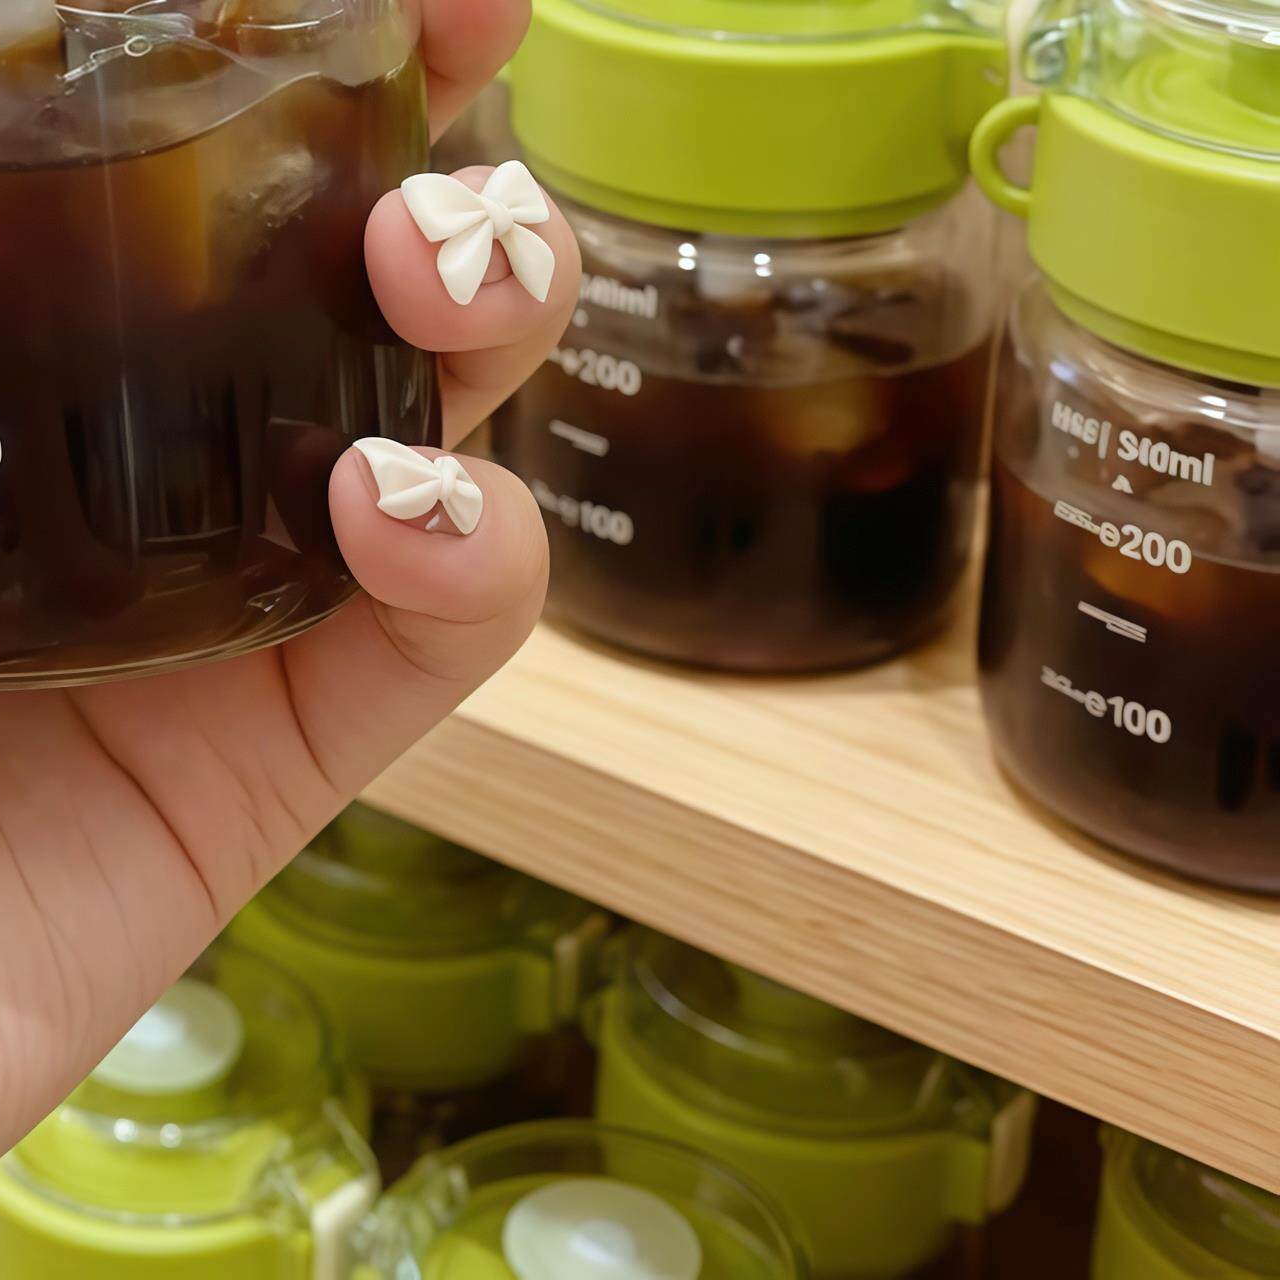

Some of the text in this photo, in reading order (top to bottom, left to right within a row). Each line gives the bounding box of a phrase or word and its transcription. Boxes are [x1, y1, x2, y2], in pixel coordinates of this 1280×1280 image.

[578, 348, 642, 396] 200
[1119, 523, 1192, 574] 200
[1106, 695, 1172, 744] 100
